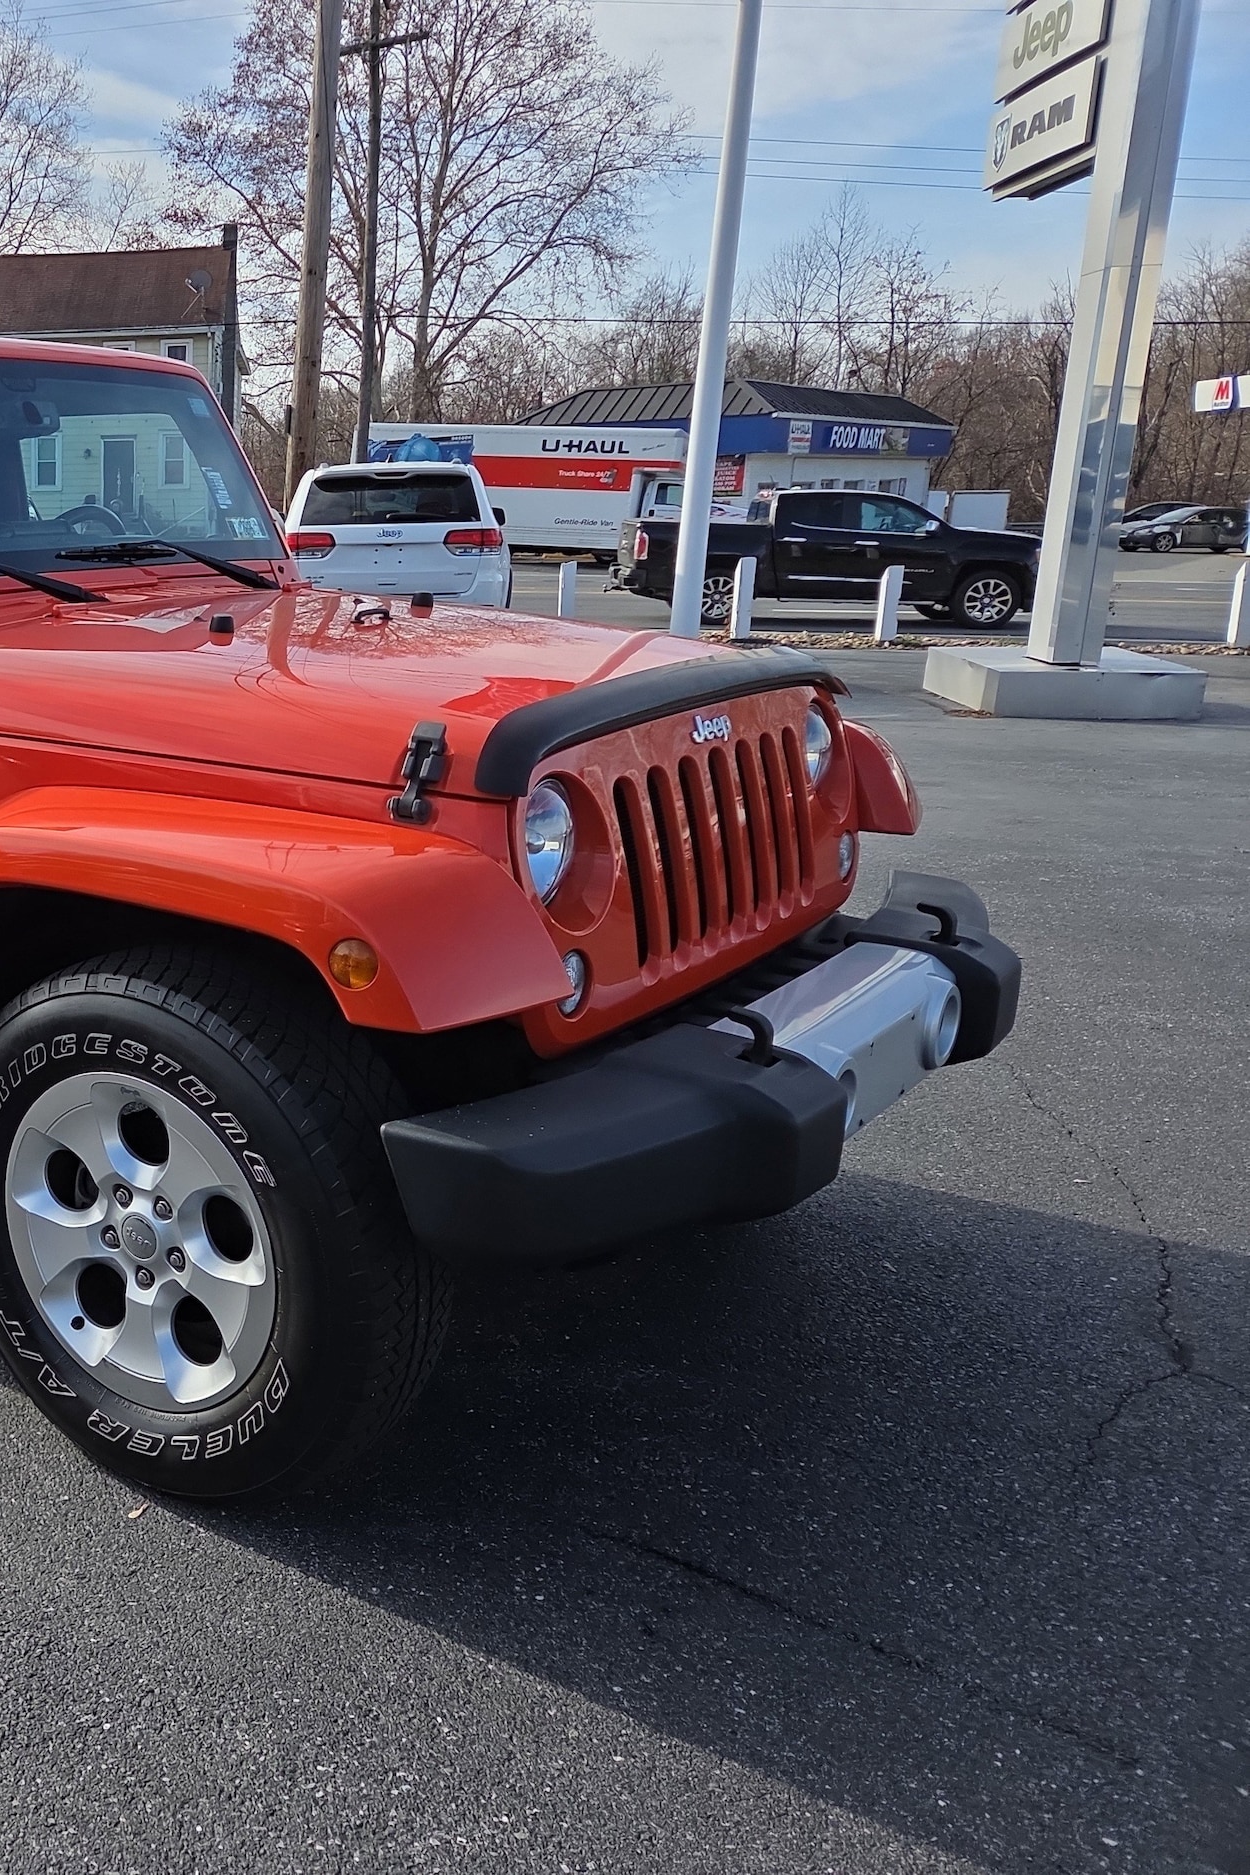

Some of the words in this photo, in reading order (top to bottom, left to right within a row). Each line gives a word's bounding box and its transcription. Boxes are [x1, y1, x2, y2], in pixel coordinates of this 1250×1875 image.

[1013, 0, 1074, 69] Jeep
[1010, 94, 1076, 150] RAM
[541, 439, 630, 454] U-HAUL
[830, 425, 858, 449] FOOD
[857, 427, 886, 450] MART
[376, 528, 403, 539] Jeep
[554, 517, 598, 526] Gentle-Ride
[600, 519, 614, 527] Van
[691, 714, 733, 743] Jeep
[85, 1357, 290, 1461] DUELER
